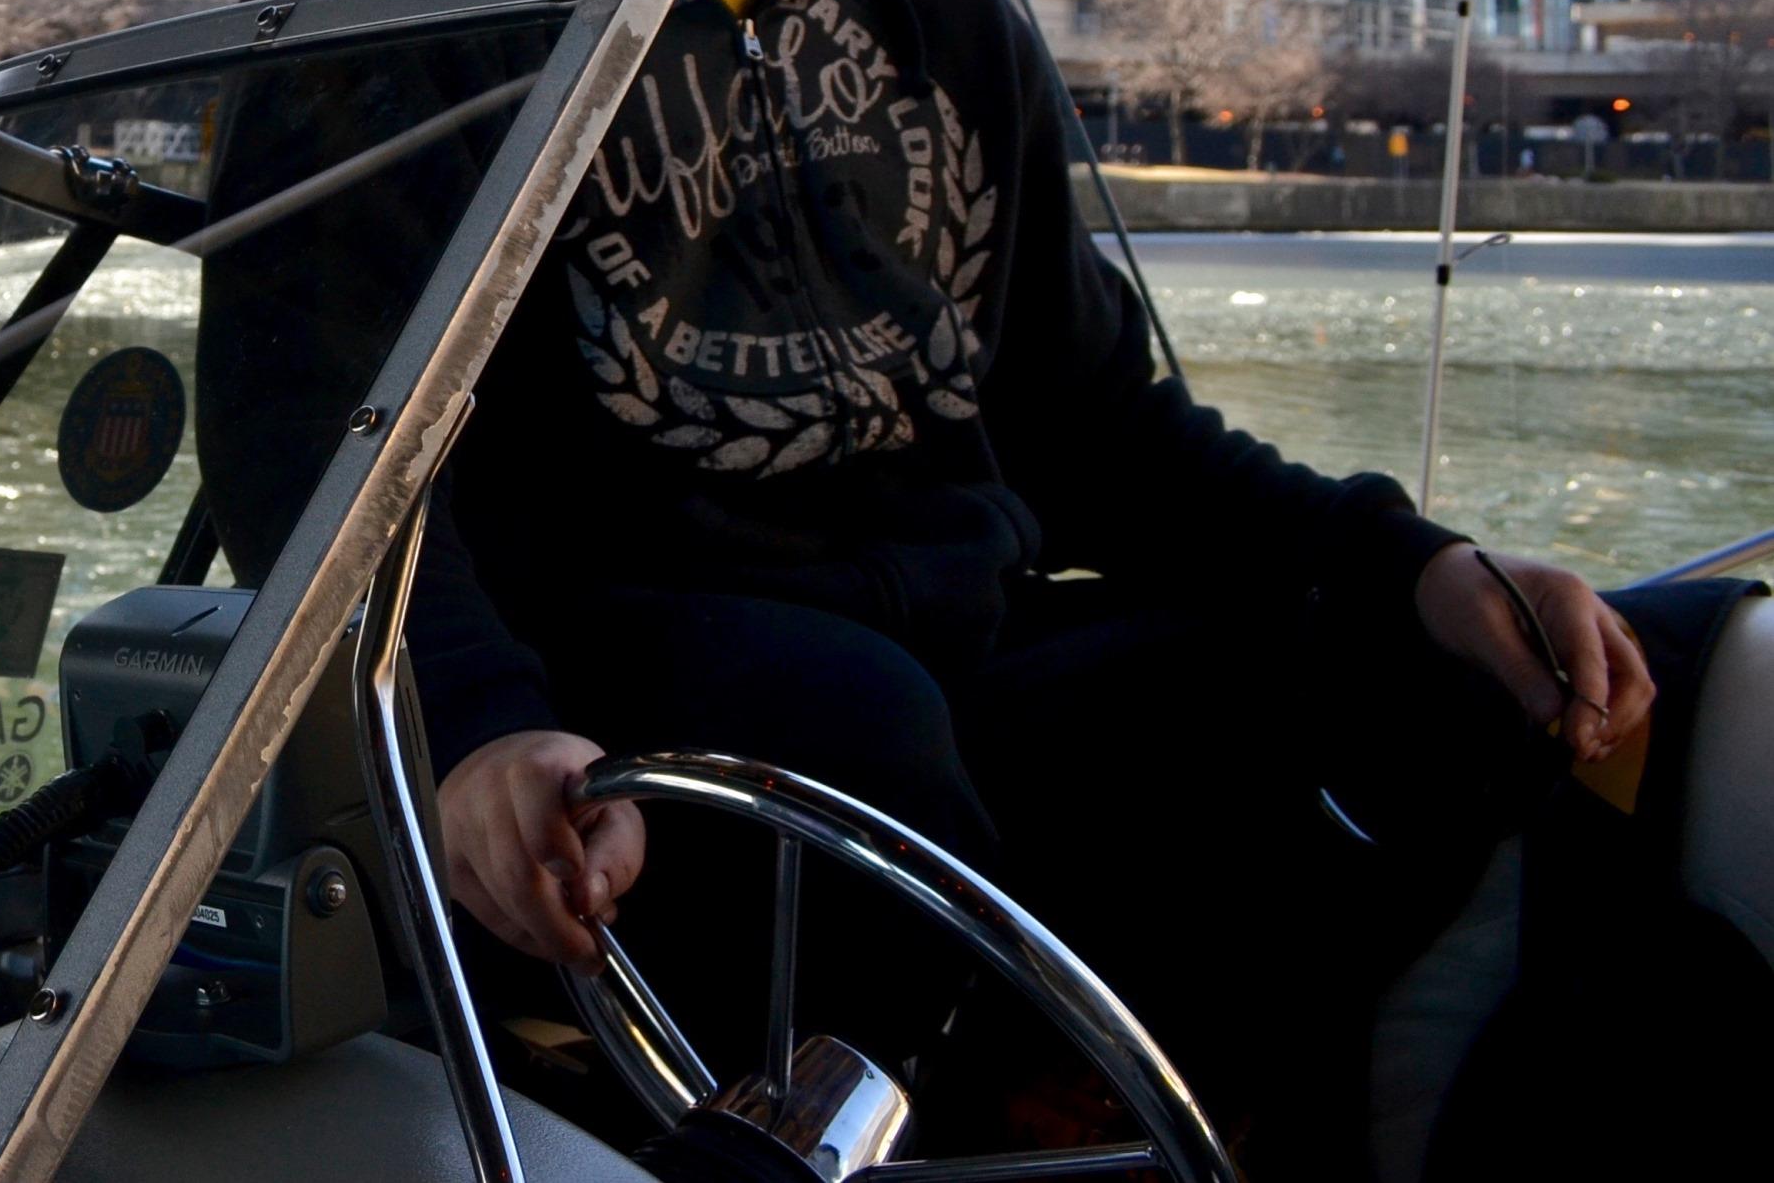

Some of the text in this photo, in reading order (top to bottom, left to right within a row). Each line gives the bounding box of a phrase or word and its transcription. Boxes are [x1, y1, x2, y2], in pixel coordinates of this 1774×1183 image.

[590, 14, 884, 240] uffalo
[888, 95, 934, 259] LOOK
[585, 230, 653, 290] OF
[637, 296, 670, 341] A
[113, 646, 205, 676] GARMIN
